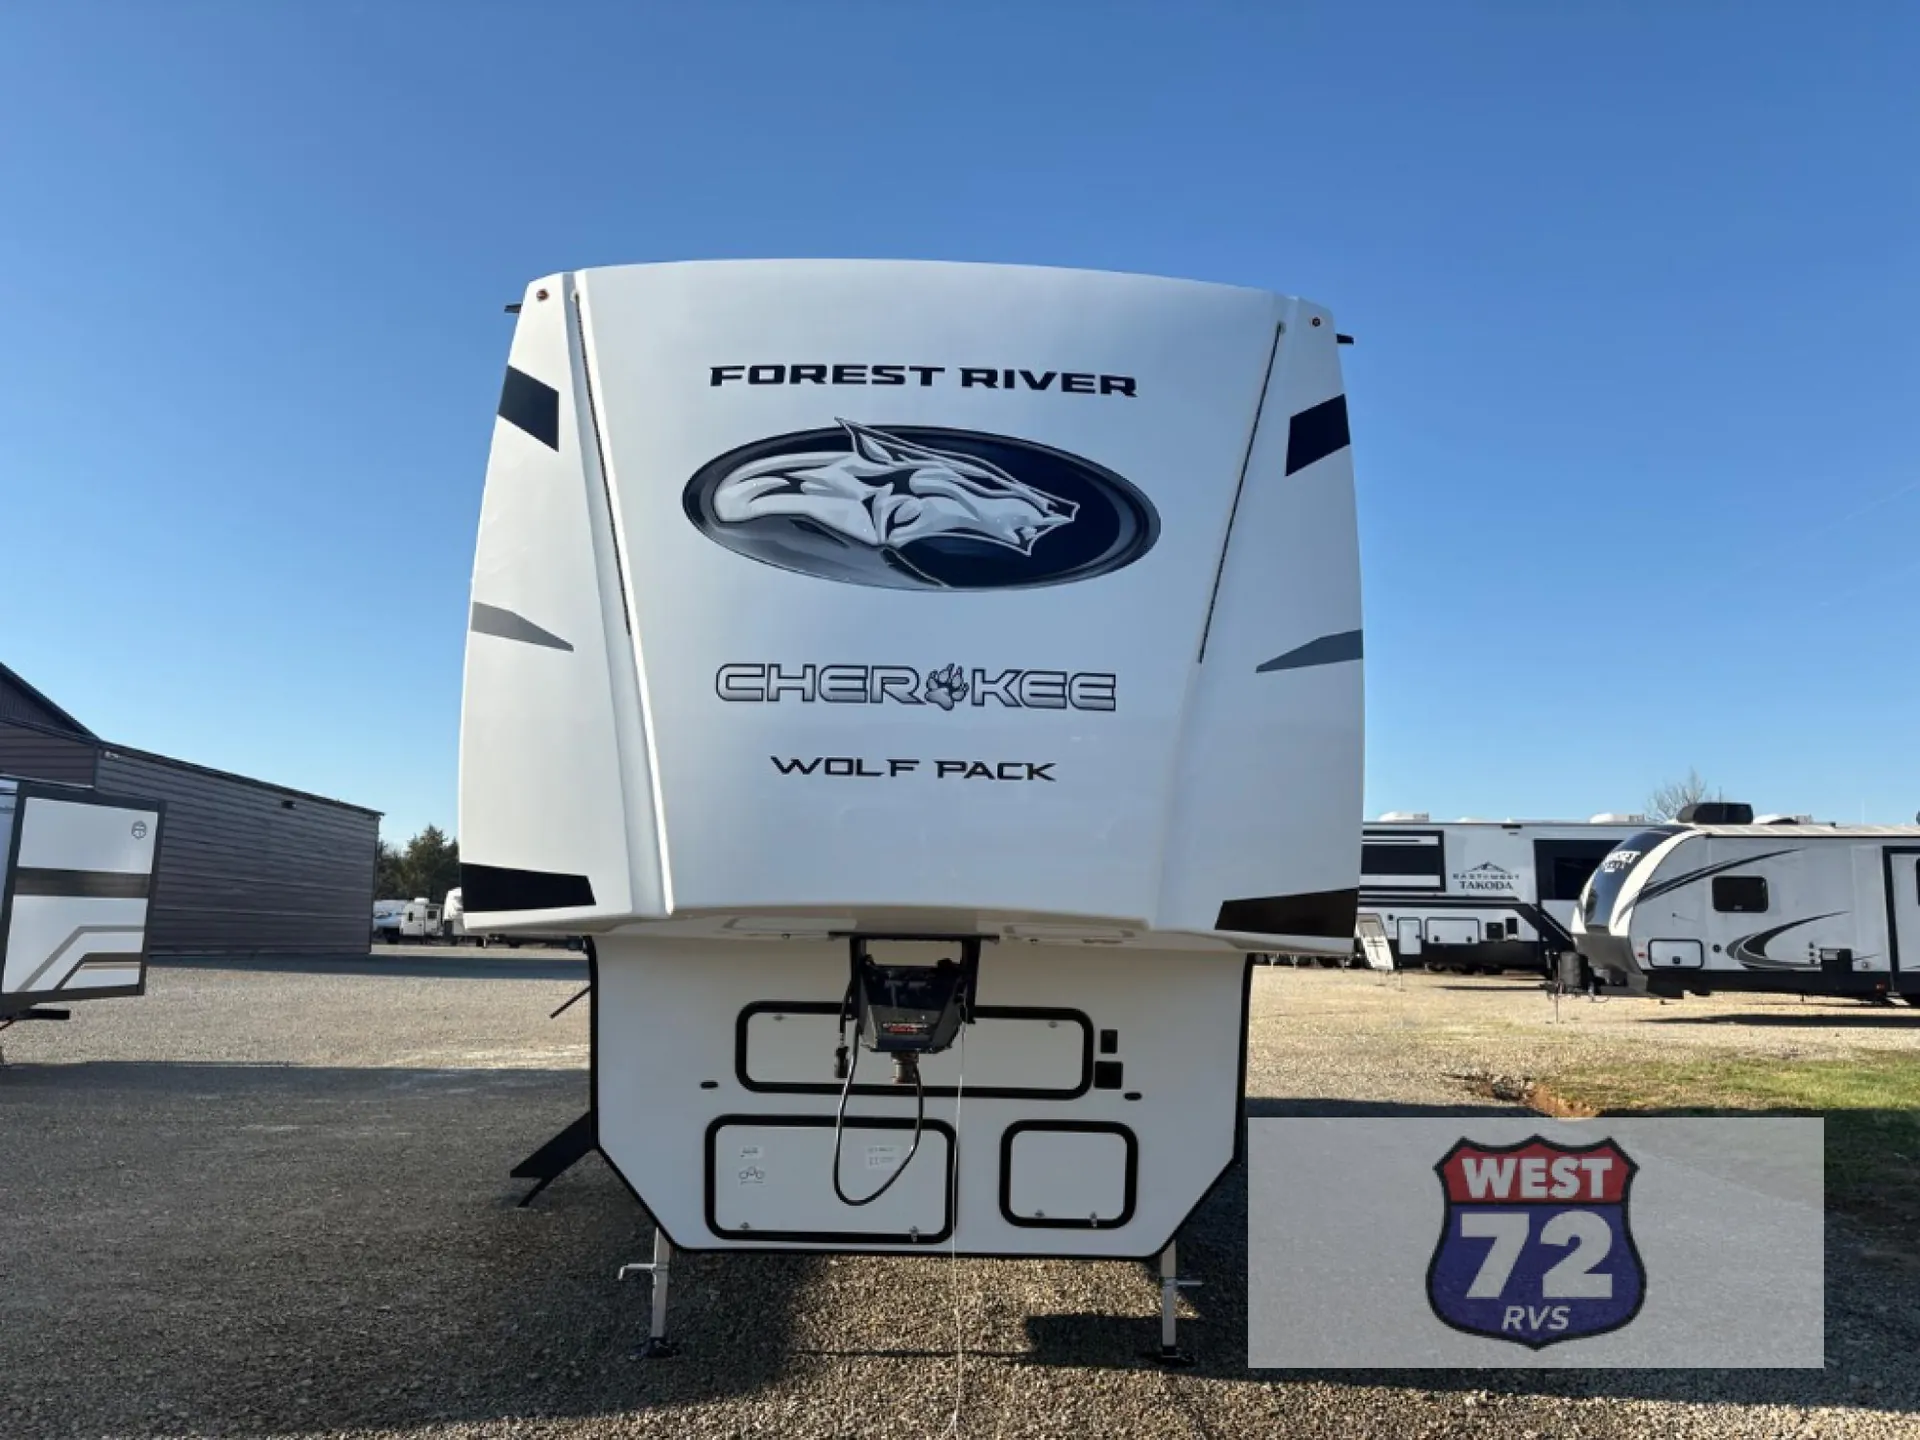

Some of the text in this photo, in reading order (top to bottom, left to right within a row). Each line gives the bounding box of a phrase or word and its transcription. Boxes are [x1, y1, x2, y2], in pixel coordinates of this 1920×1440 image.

[710, 364, 1138, 398] FOREST RIVER
[770, 755, 1056, 782] WOLF PACK
[1459, 880, 1514, 890] TAKODA
